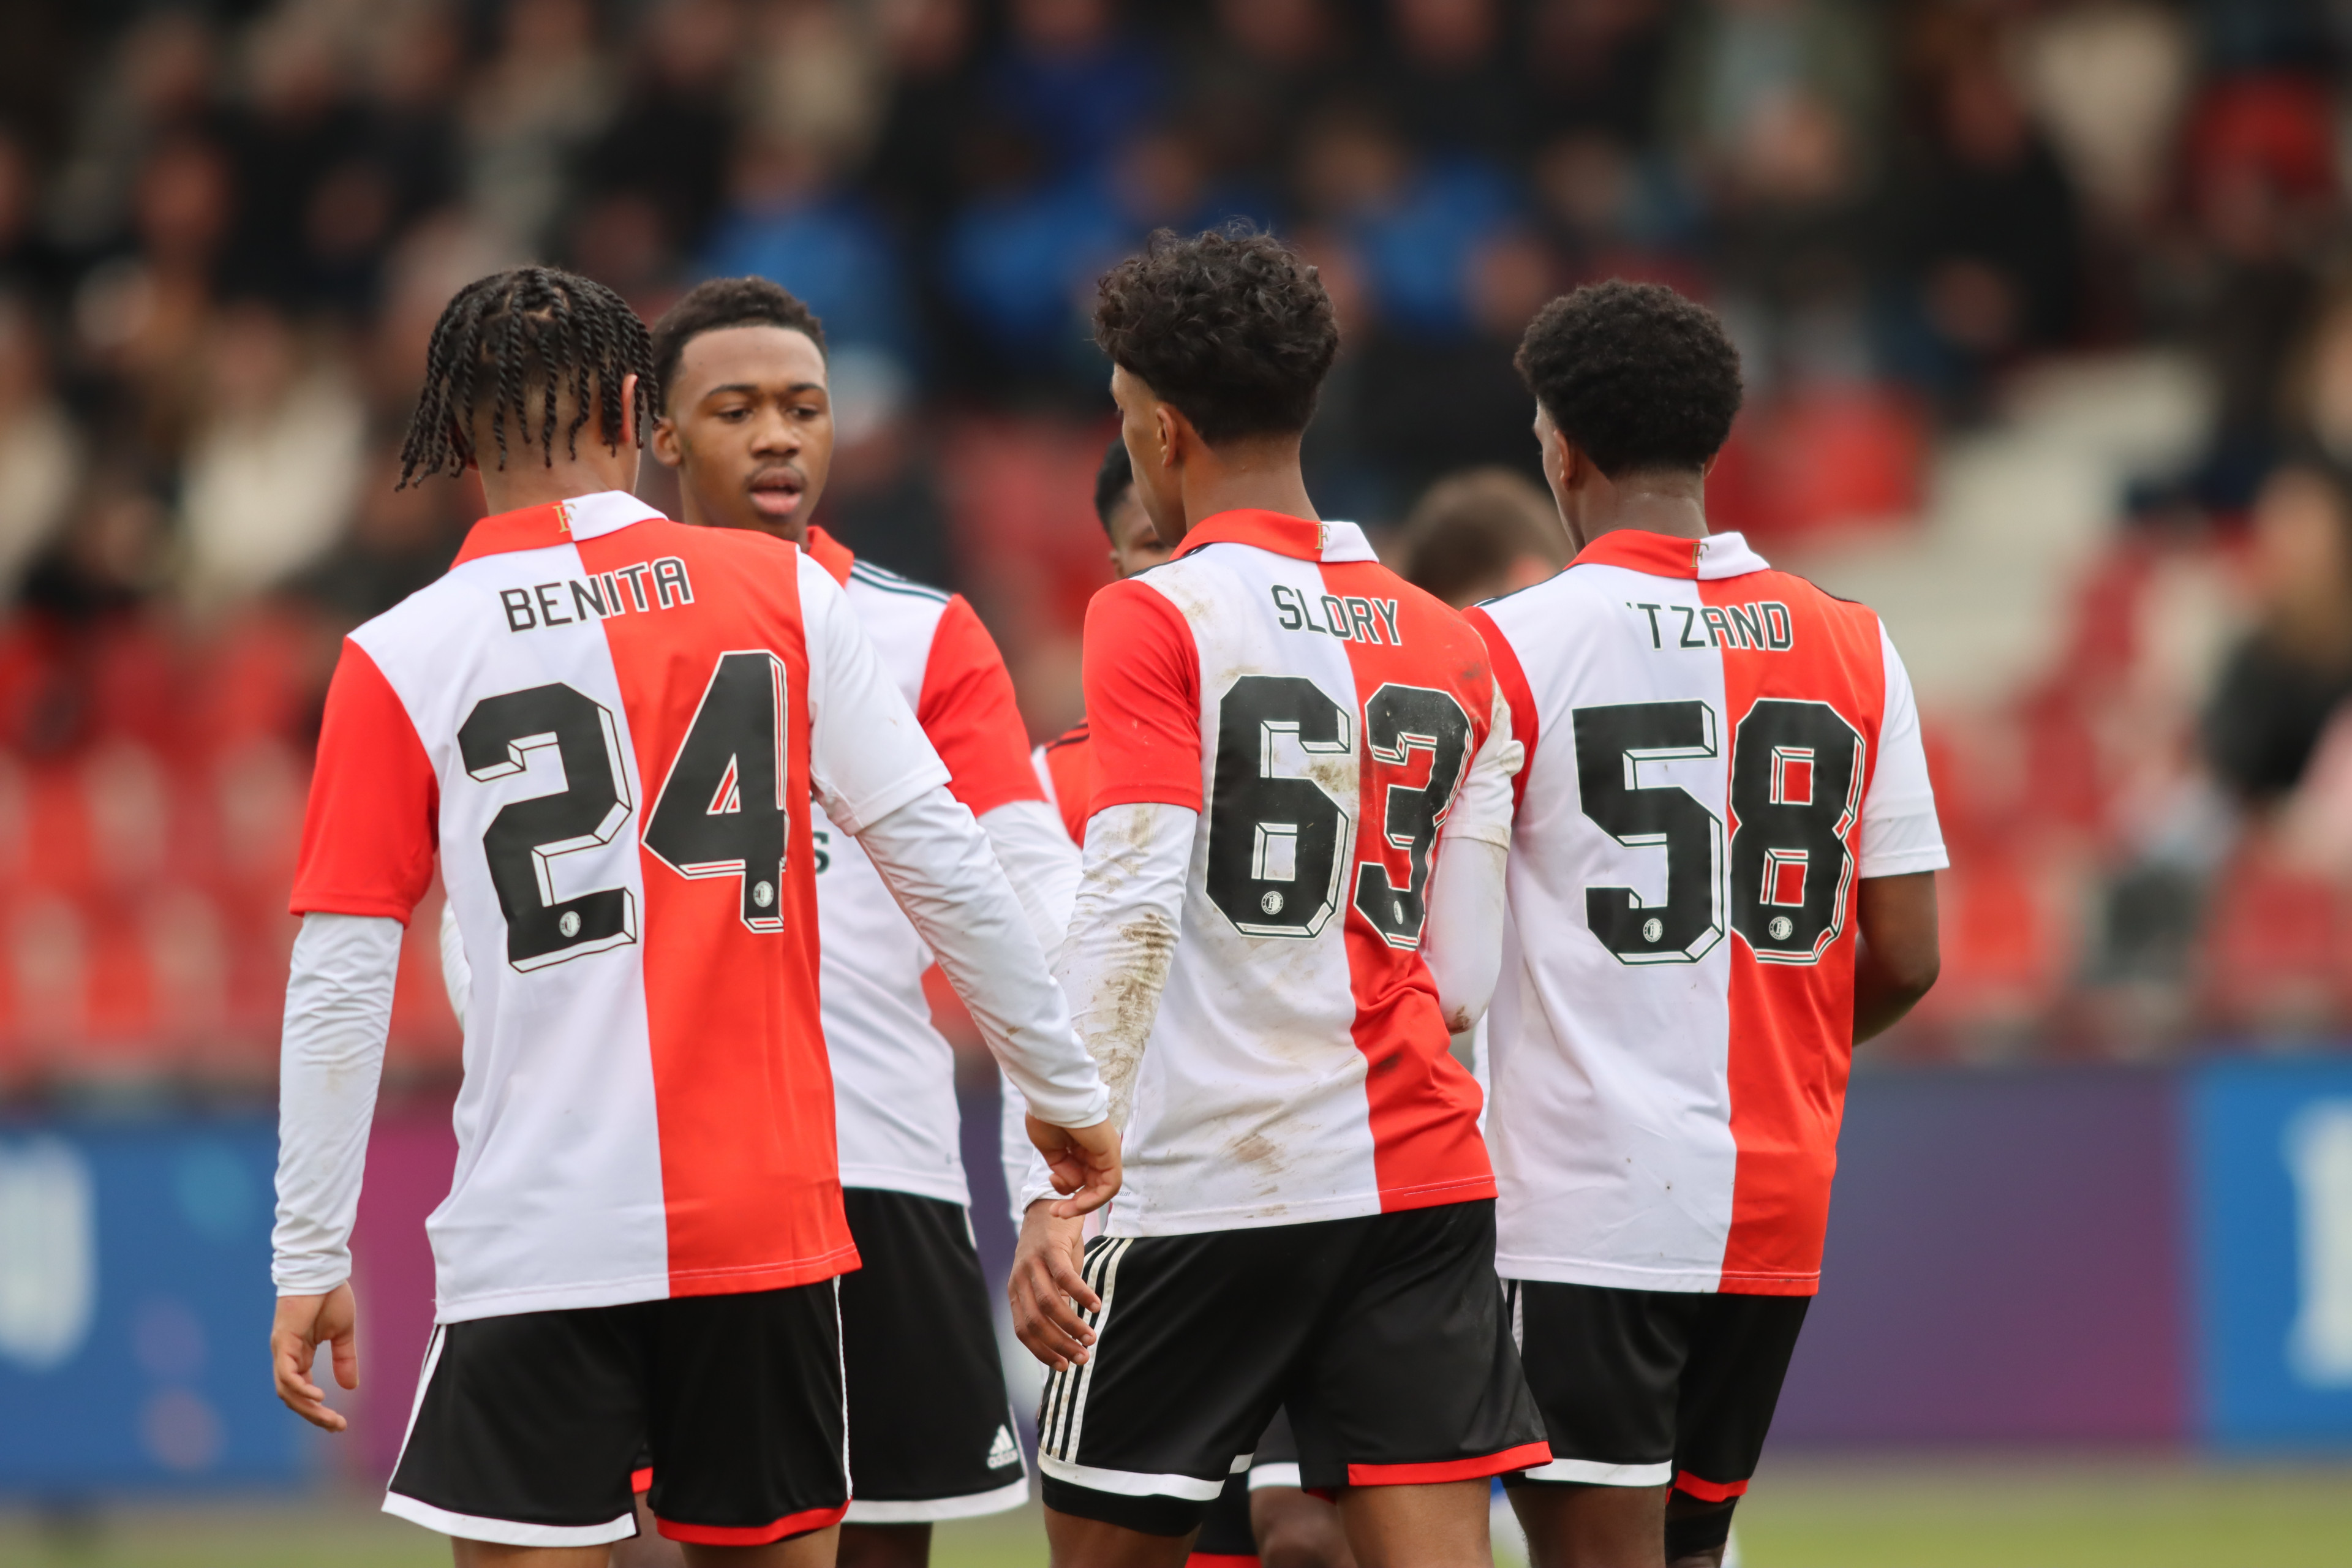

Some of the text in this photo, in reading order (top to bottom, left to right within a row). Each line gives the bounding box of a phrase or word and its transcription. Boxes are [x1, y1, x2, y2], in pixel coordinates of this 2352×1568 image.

[500, 556, 695, 633] BENITA
[1270, 584, 1402, 646] SLORY
[457, 650, 790, 973] 24
[1205, 674, 1474, 951] 63
[1572, 698, 1866, 967] 58
